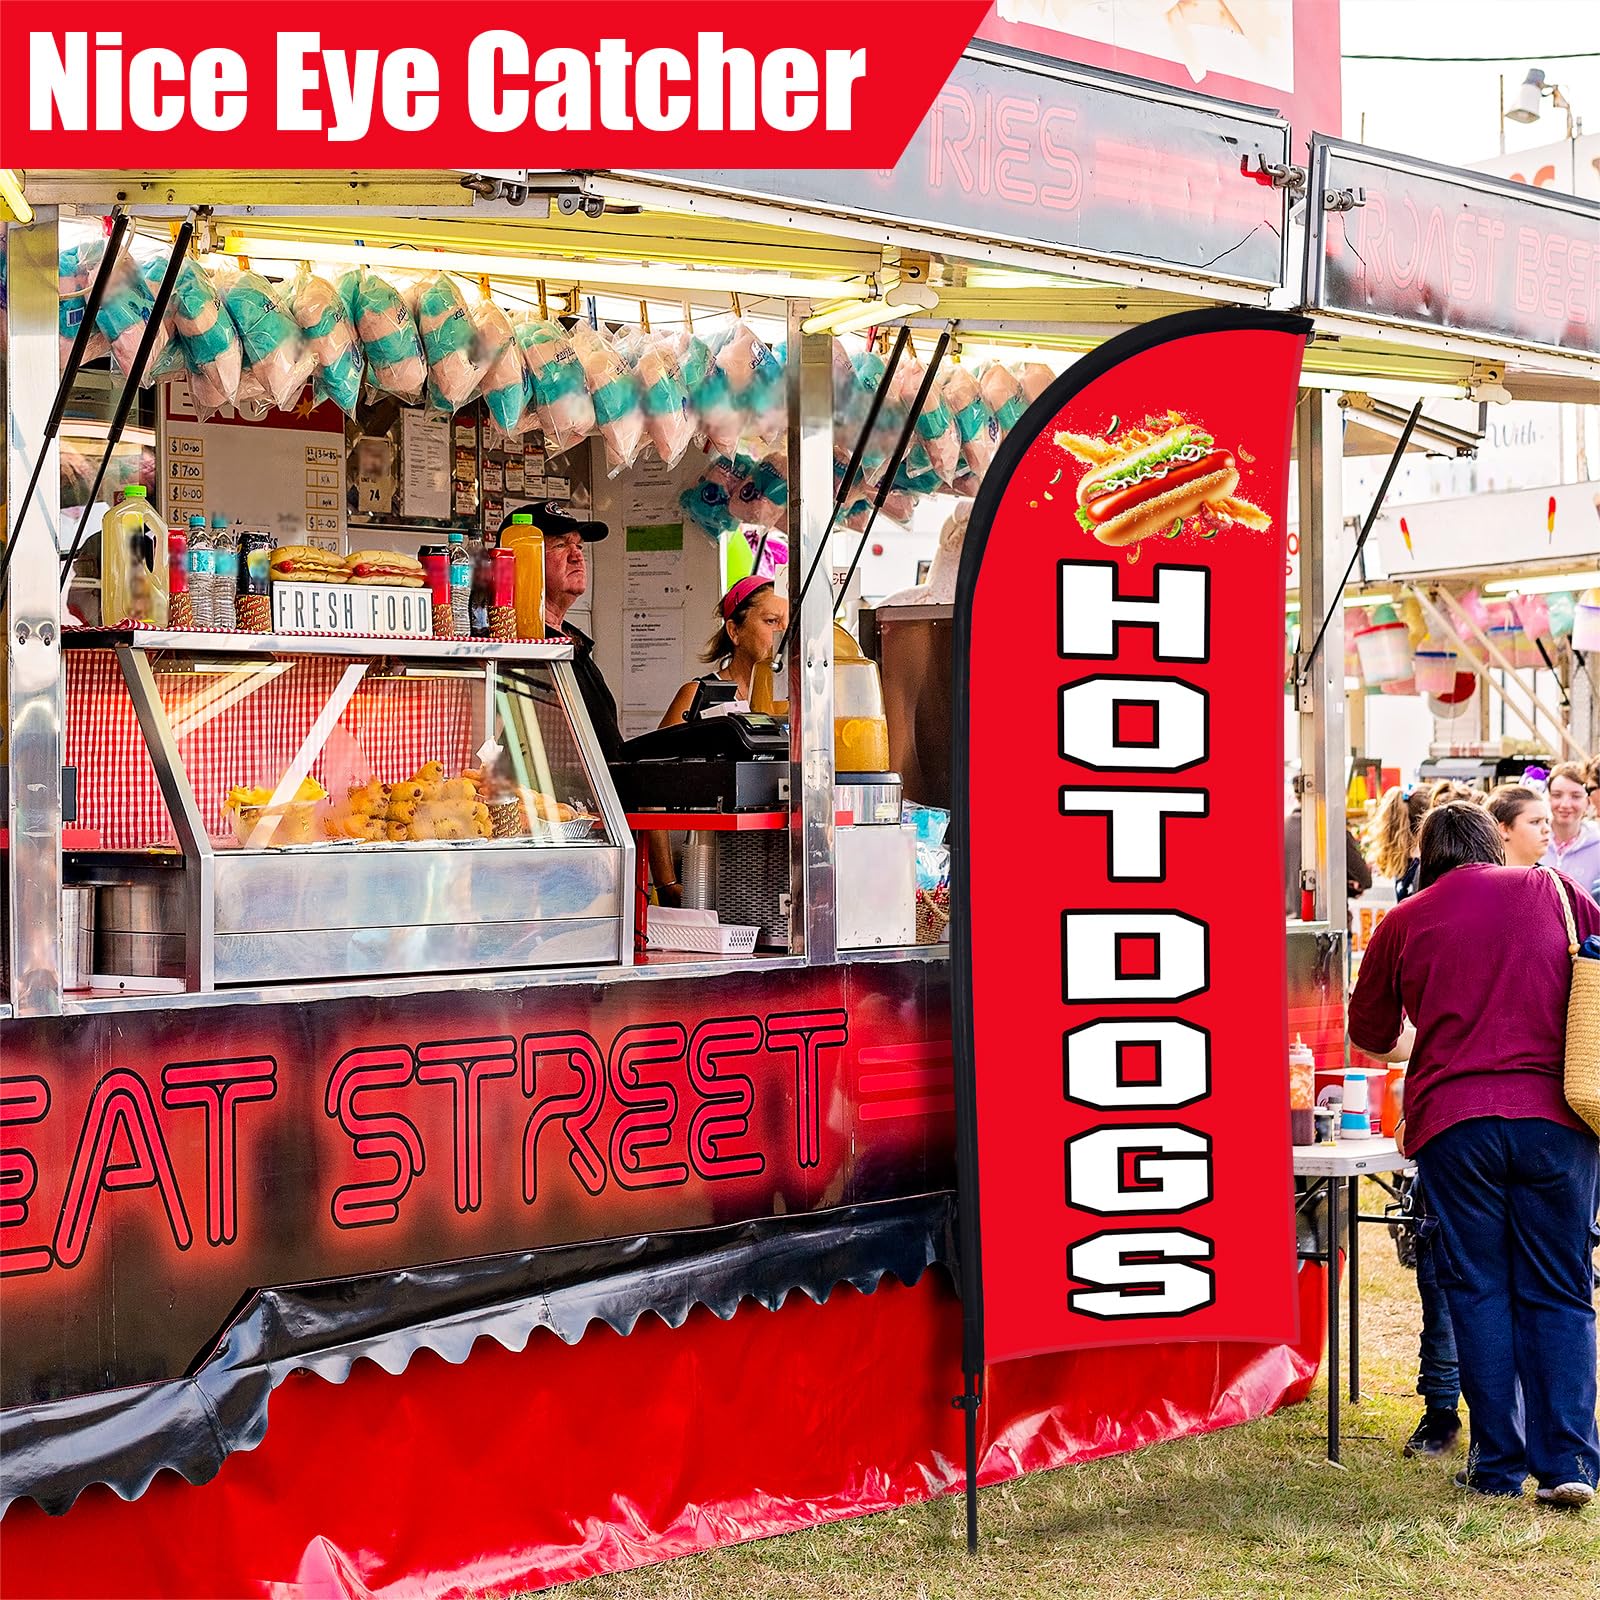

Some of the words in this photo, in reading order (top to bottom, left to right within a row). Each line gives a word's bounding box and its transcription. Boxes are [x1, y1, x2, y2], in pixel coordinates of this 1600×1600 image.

[928, 83, 1084, 211] RIES
[1355, 190, 1505, 305] ROAST
[1514, 226, 1600, 326] BEE
[278, 590, 354, 630] FRESH
[371, 594, 428, 633] FOOD
[1057, 559, 1211, 884] HOT
[325, 1006, 849, 1232] STREET
[1061, 908, 1215, 1321] DOGS
